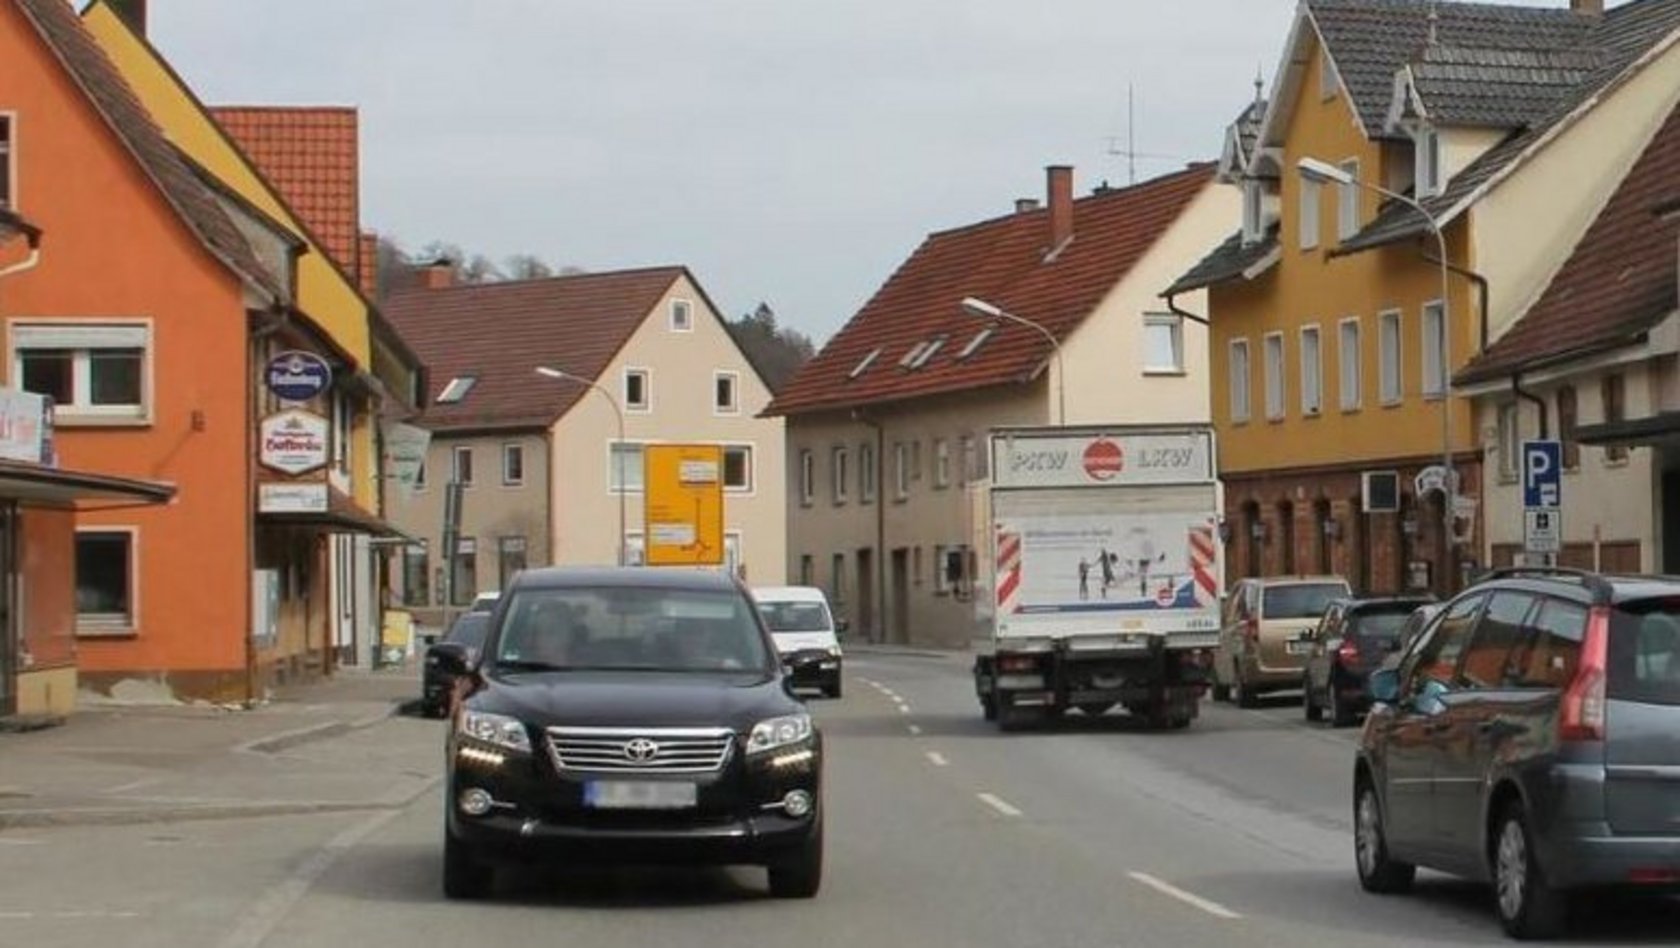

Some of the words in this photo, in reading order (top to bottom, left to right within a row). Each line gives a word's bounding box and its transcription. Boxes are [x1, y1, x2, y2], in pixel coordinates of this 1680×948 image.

[1011, 450, 1068, 471] PKW
[1136, 448, 1193, 468] LKW
[1528, 451, 1549, 488] P
